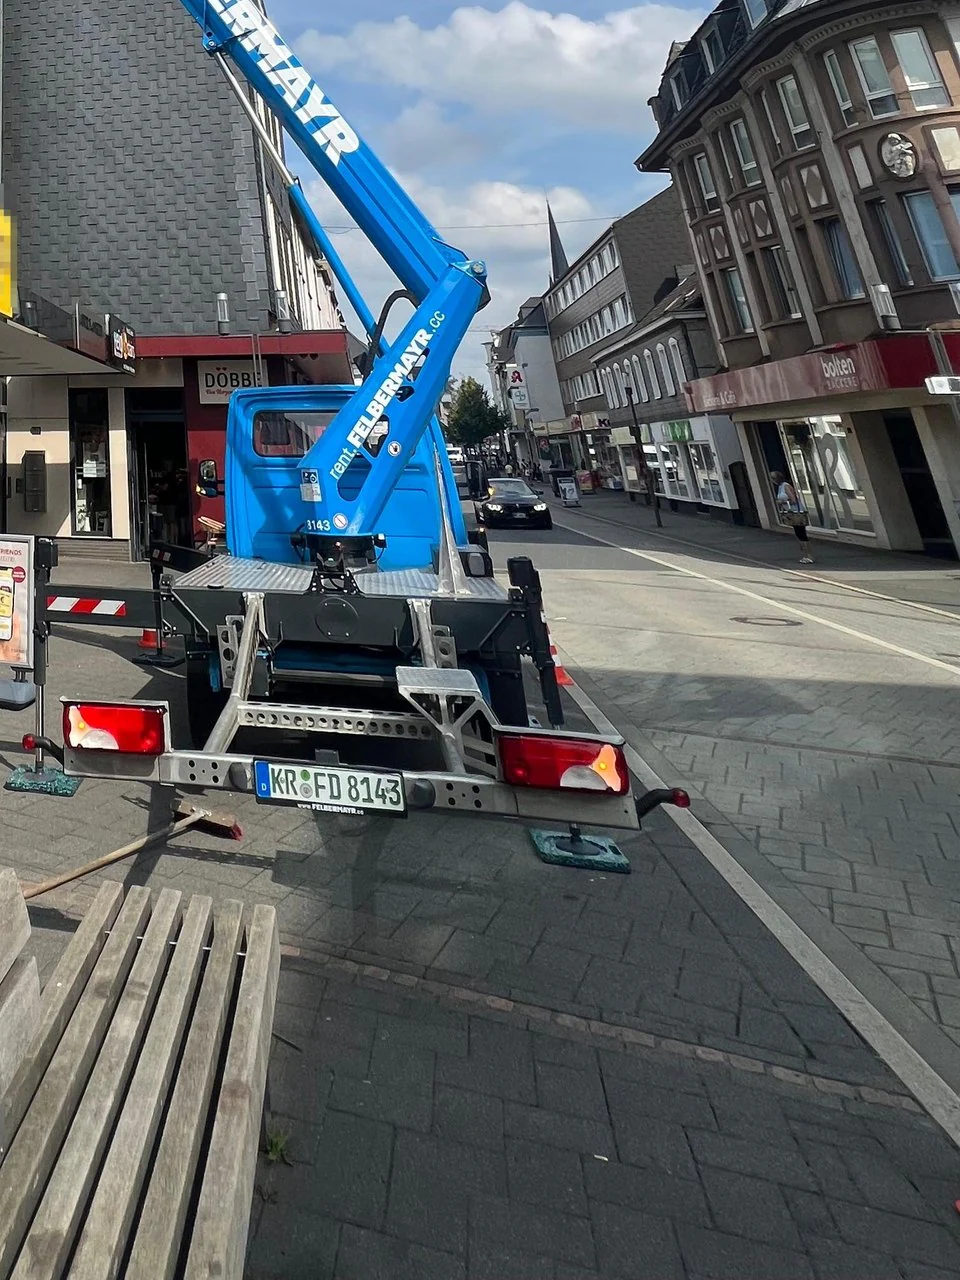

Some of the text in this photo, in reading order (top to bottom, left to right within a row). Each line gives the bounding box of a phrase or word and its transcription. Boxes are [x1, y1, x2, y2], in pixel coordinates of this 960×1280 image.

[820, 355, 855, 377] bolten
[271, 767, 401, 806] KR FD 8143
